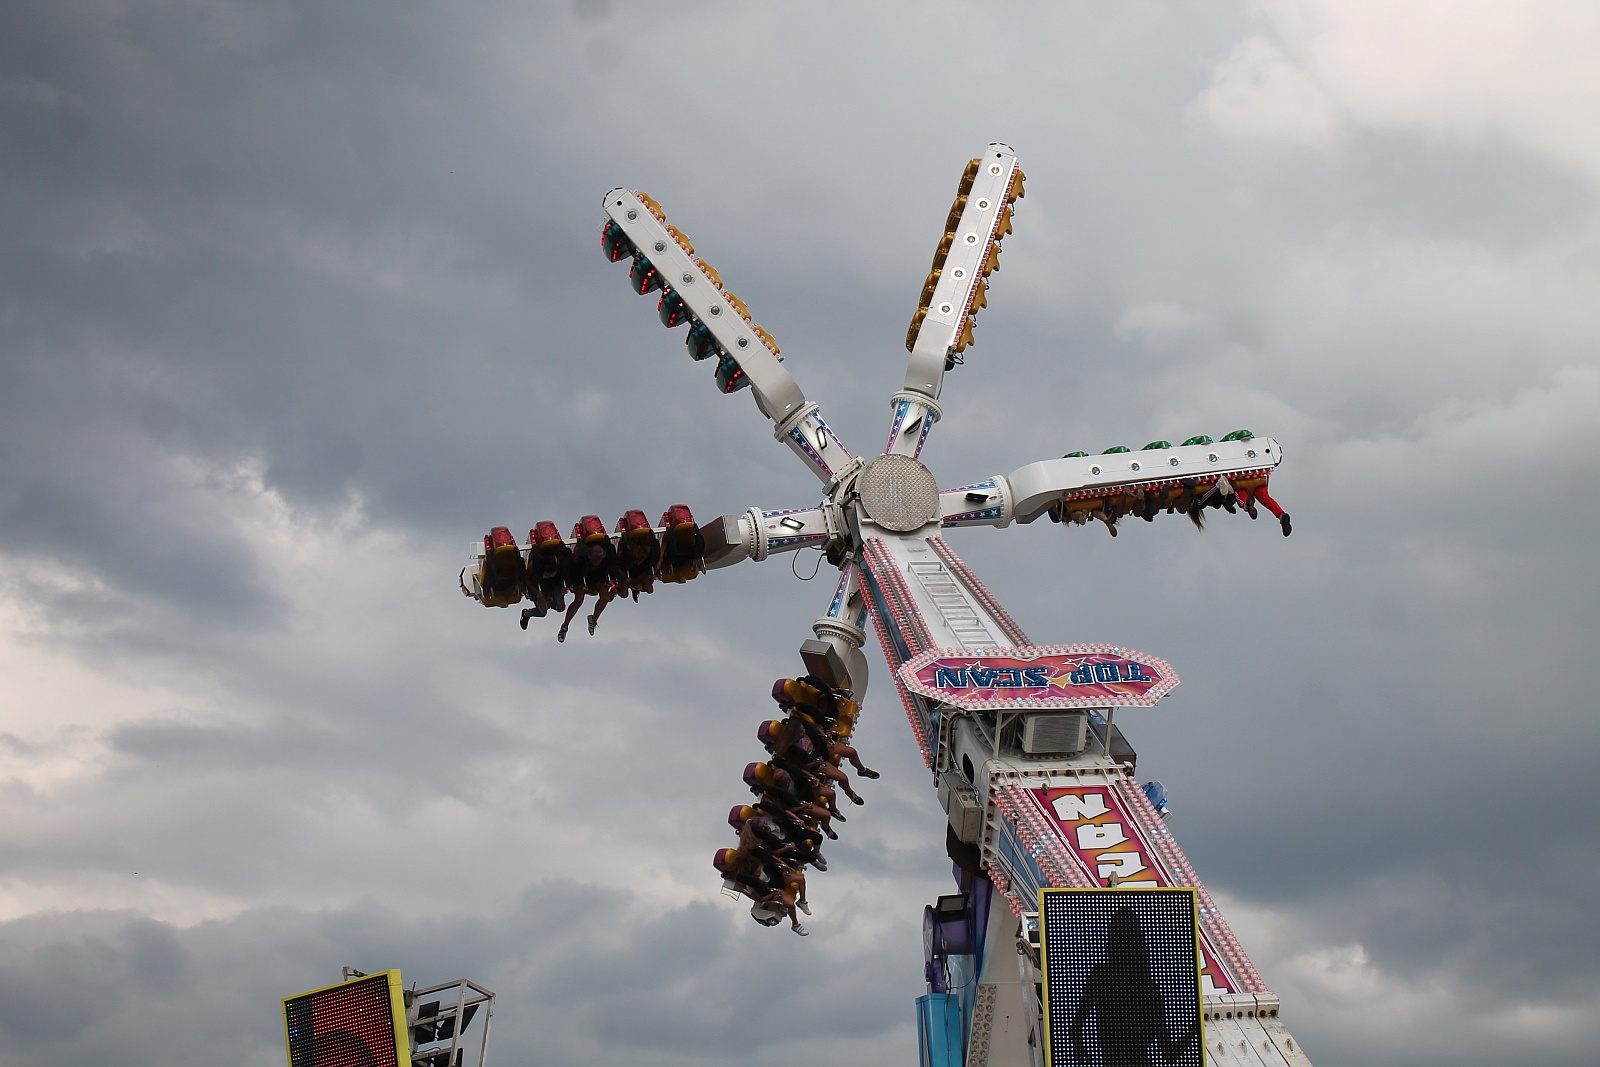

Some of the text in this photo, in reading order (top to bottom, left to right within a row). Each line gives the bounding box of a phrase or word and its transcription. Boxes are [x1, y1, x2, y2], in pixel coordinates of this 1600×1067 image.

[934, 661, 1152, 688] TOP SCAN
[1052, 793, 1159, 887] CAN
